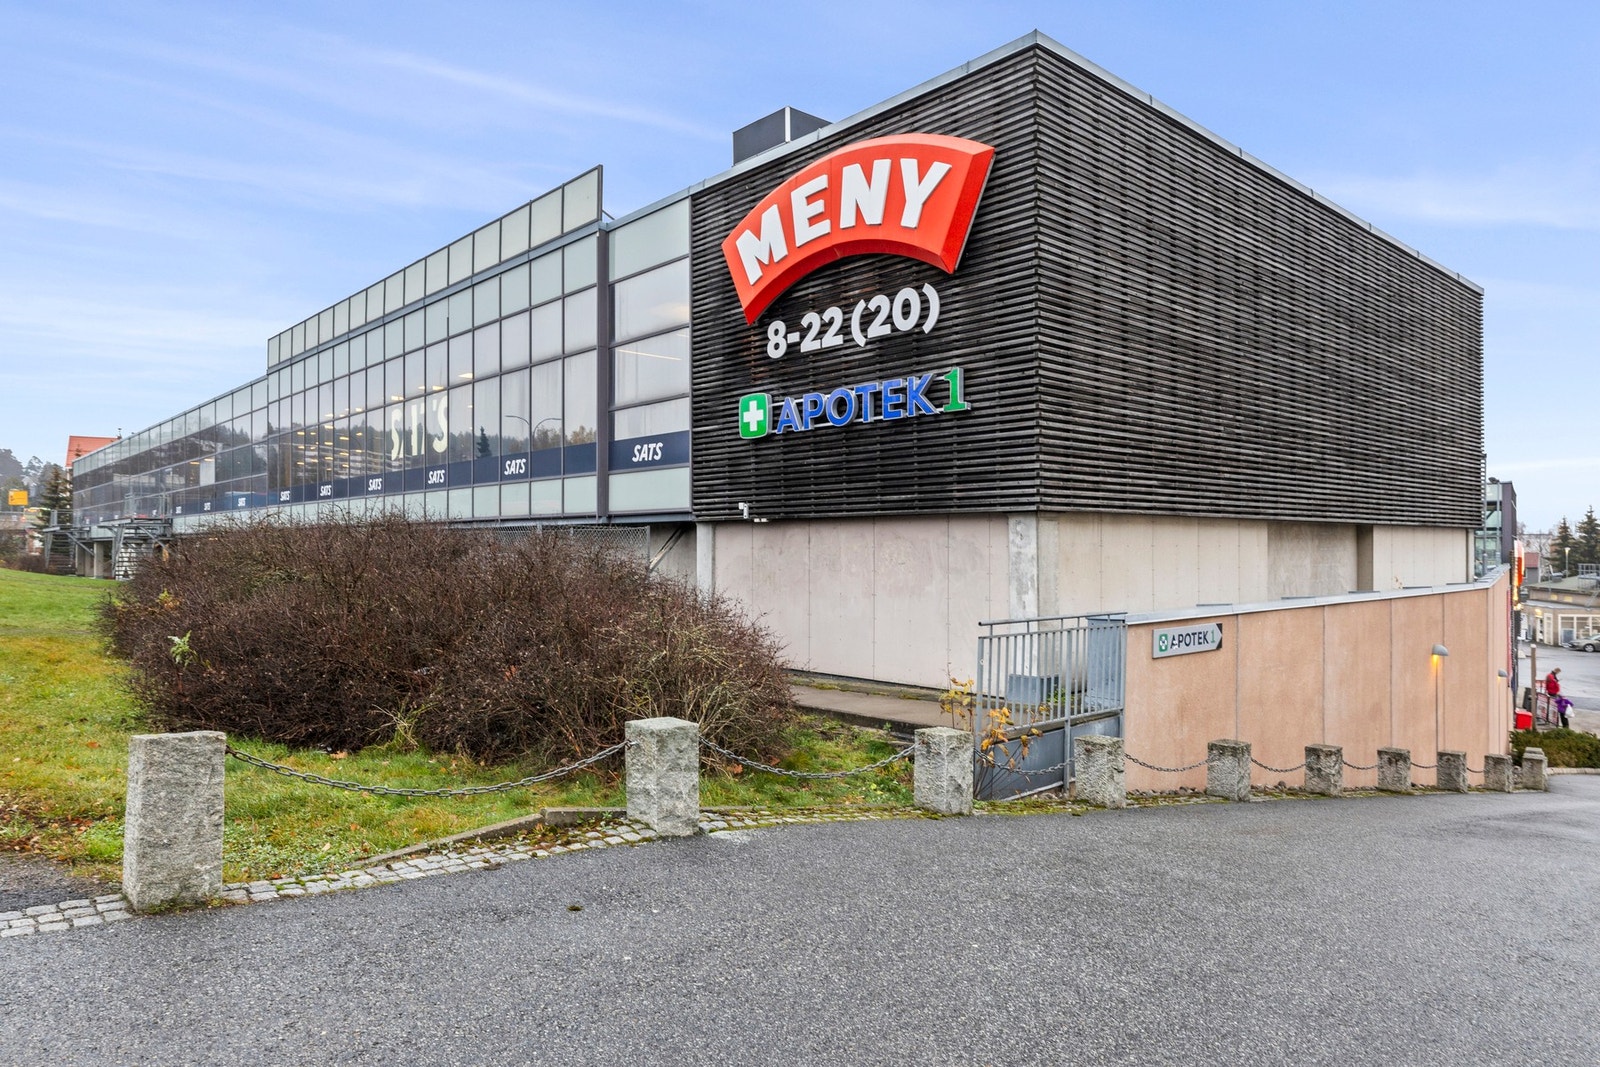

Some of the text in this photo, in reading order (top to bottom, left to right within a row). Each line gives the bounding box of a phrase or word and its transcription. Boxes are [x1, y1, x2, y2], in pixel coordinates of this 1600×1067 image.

[736, 158, 952, 286] MENY
[766, 283, 941, 359] 8-22 (20)
[776, 367, 971, 434] APOTEK 1
[632, 442, 663, 462] SATS
[504, 458, 527, 475] SATS
[368, 478, 383, 491] SATS
[428, 470, 446, 484] SATS
[320, 485, 332, 496] SATS
[1170, 630, 1216, 649] APOTEK 1
